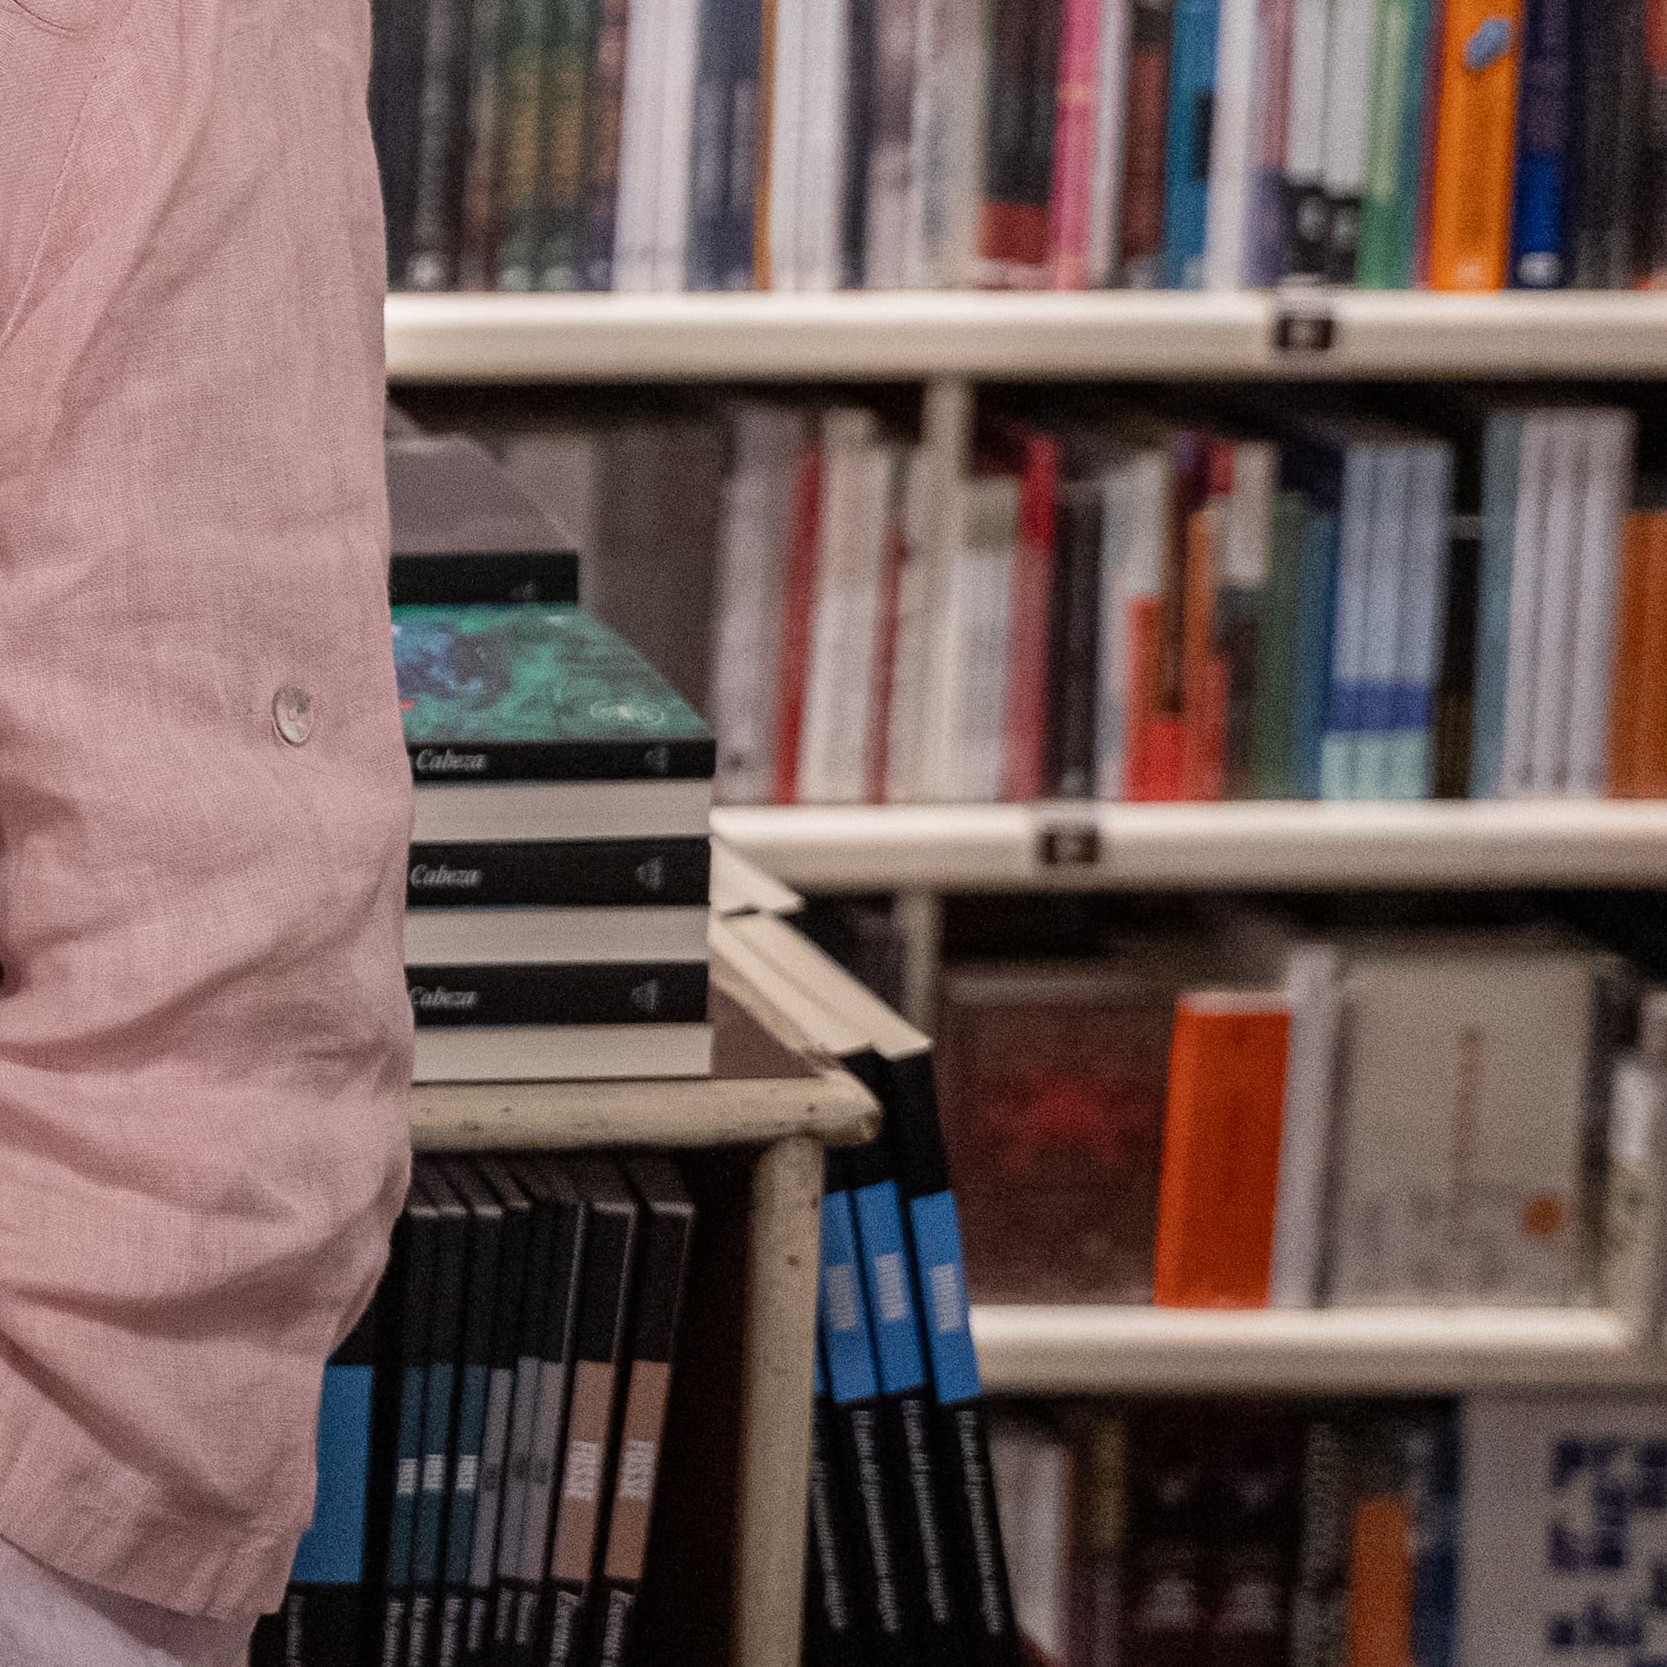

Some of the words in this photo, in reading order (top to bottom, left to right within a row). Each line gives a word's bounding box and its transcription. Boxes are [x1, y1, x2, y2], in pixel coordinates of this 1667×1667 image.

[417, 748, 488, 772] Cabeza
[410, 864, 483, 888] Cabeza
[409, 986, 479, 1011] Cabeza
